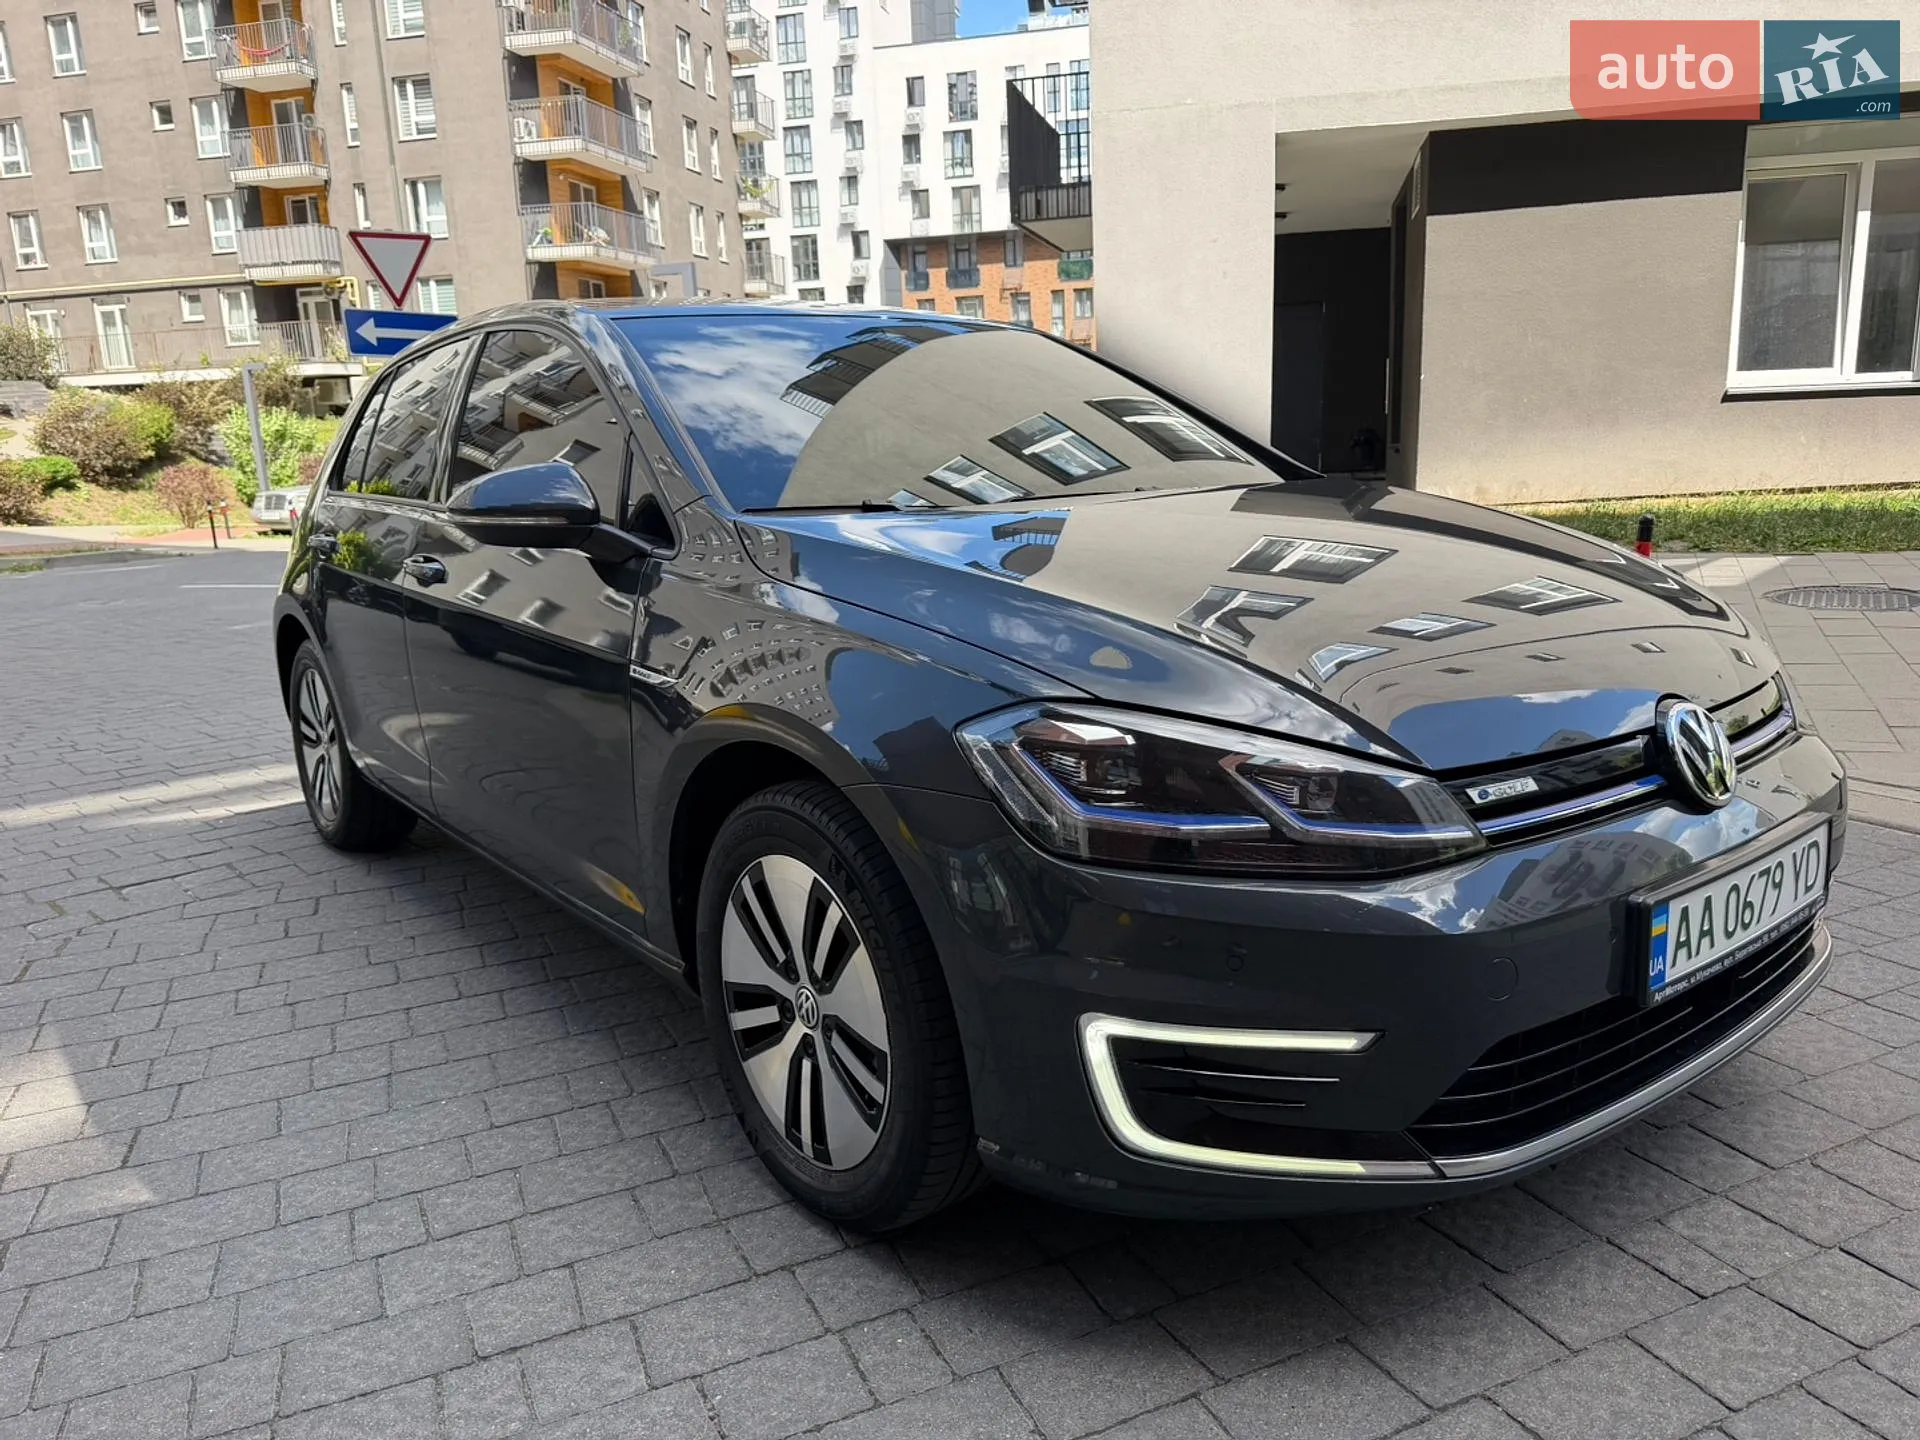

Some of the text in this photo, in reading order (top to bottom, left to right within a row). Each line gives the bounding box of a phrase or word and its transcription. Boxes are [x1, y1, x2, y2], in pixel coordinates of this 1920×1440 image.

[1671, 894, 1715, 968] AA
[1724, 859, 1785, 940] 0679
[1792, 839, 1820, 901] YD
[1650, 955, 1664, 976] UA
